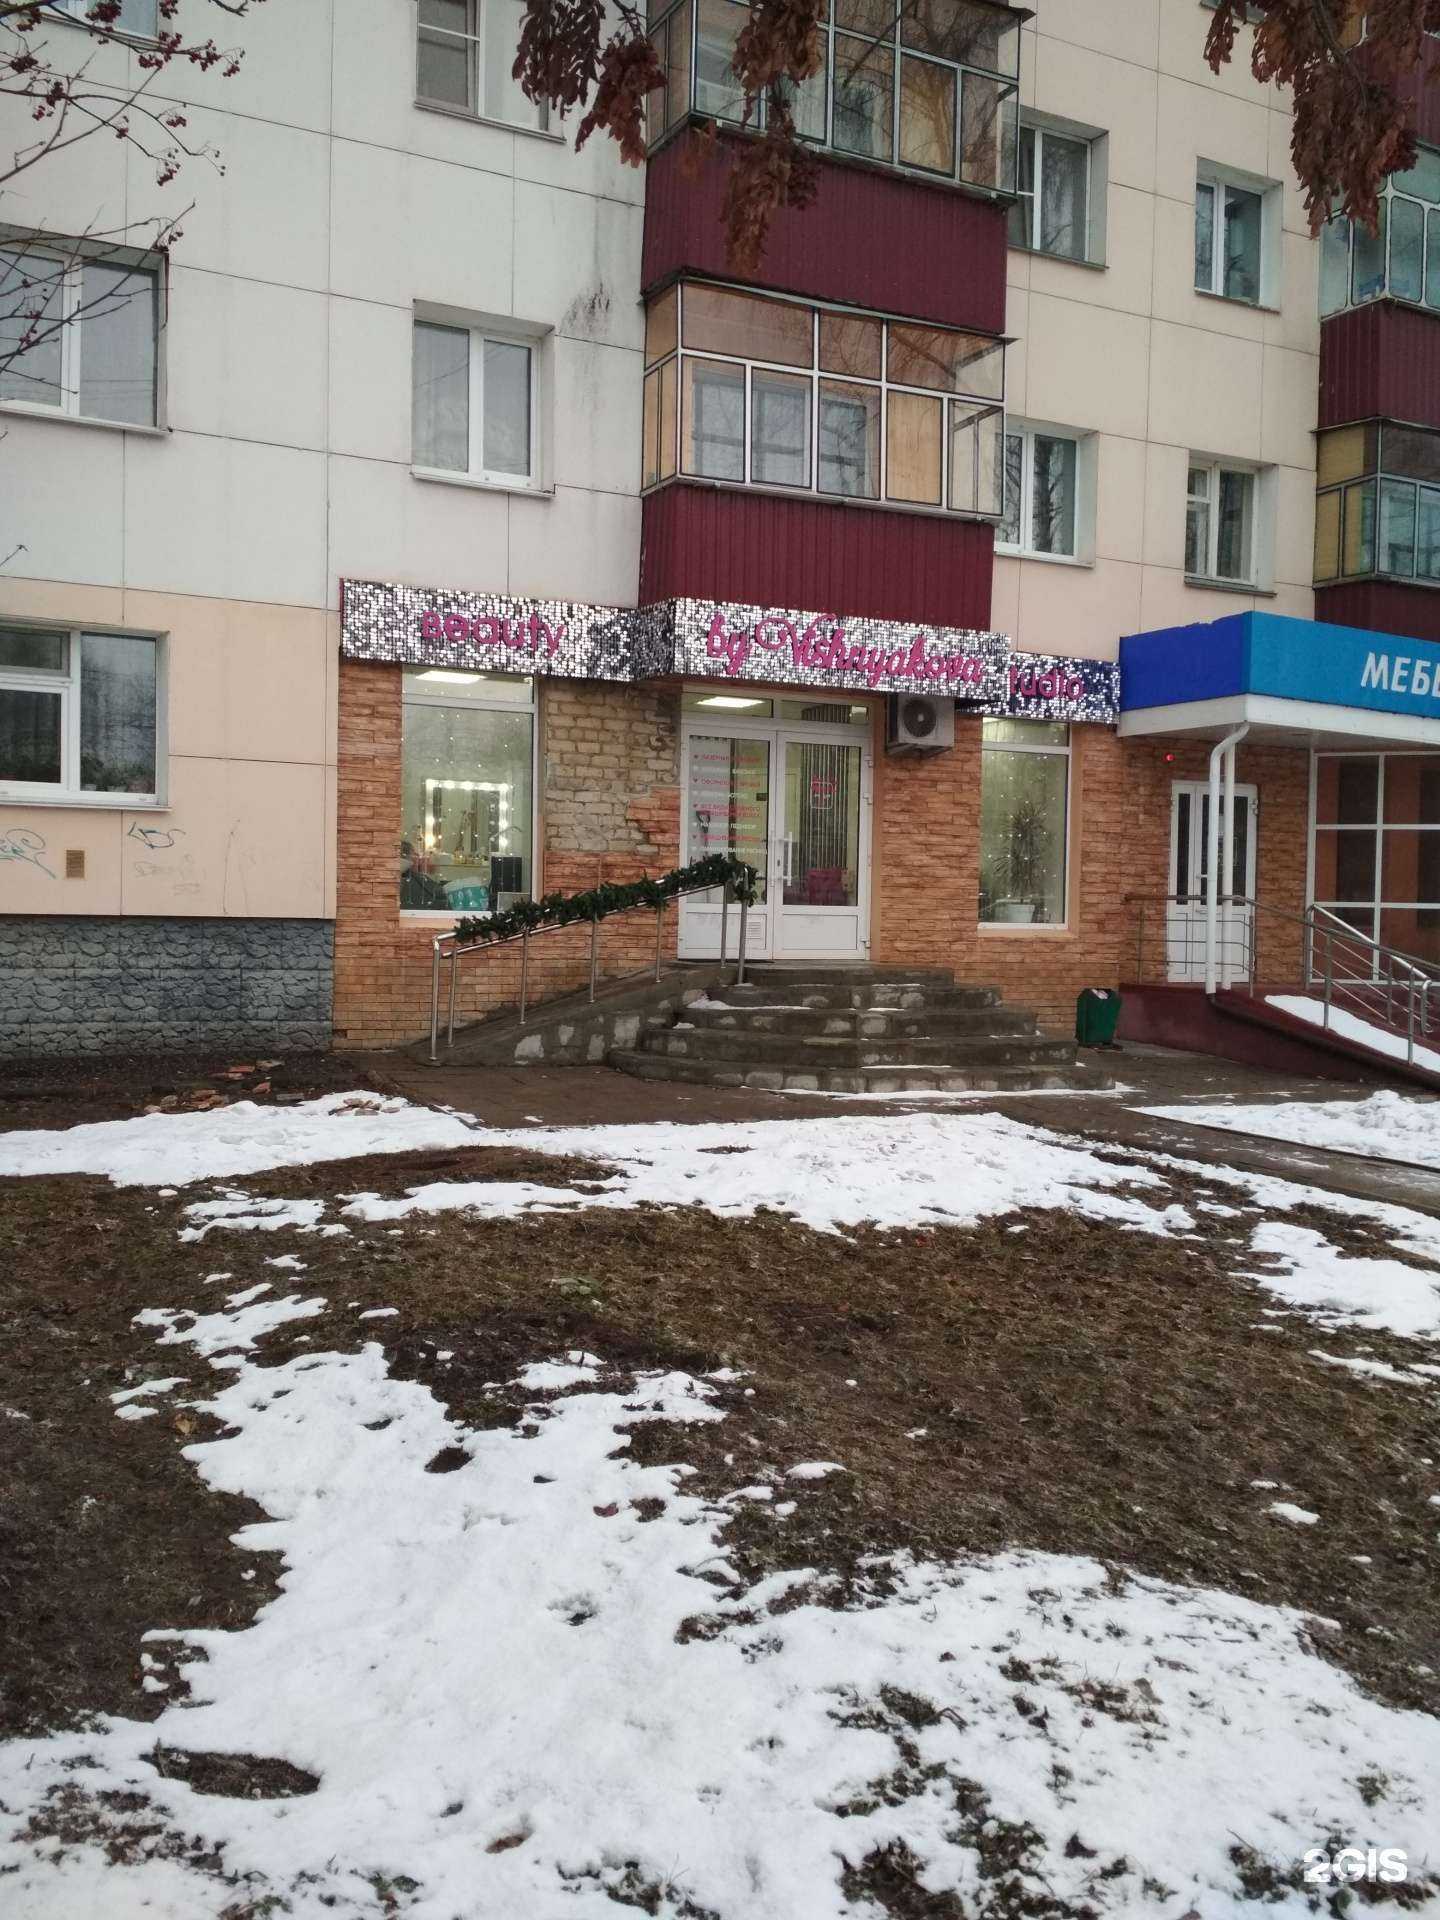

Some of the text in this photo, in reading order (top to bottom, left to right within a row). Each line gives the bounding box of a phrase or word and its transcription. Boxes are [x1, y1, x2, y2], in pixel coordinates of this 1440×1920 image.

[421, 610, 567, 658] Beauty
[706, 611, 983, 688] by Vishnyakova
[1008, 659, 1084, 700] tudio
